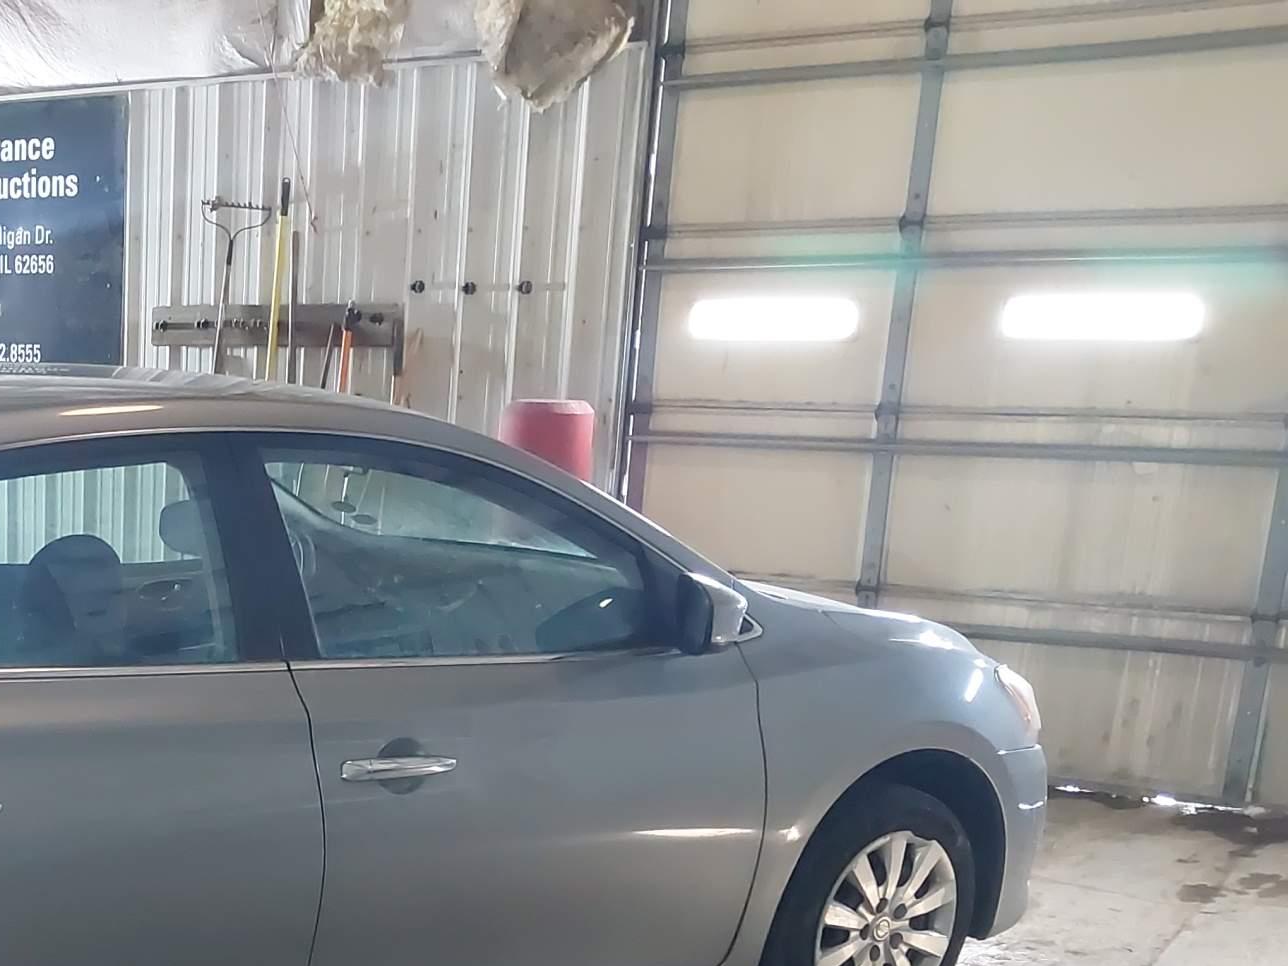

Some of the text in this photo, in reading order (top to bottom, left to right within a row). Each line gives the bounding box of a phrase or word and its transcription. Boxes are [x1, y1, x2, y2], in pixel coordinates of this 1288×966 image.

[35, 225, 54, 245] Dr.
[0, 254, 12, 275] IL
[14, 254, 54, 275] 62656
